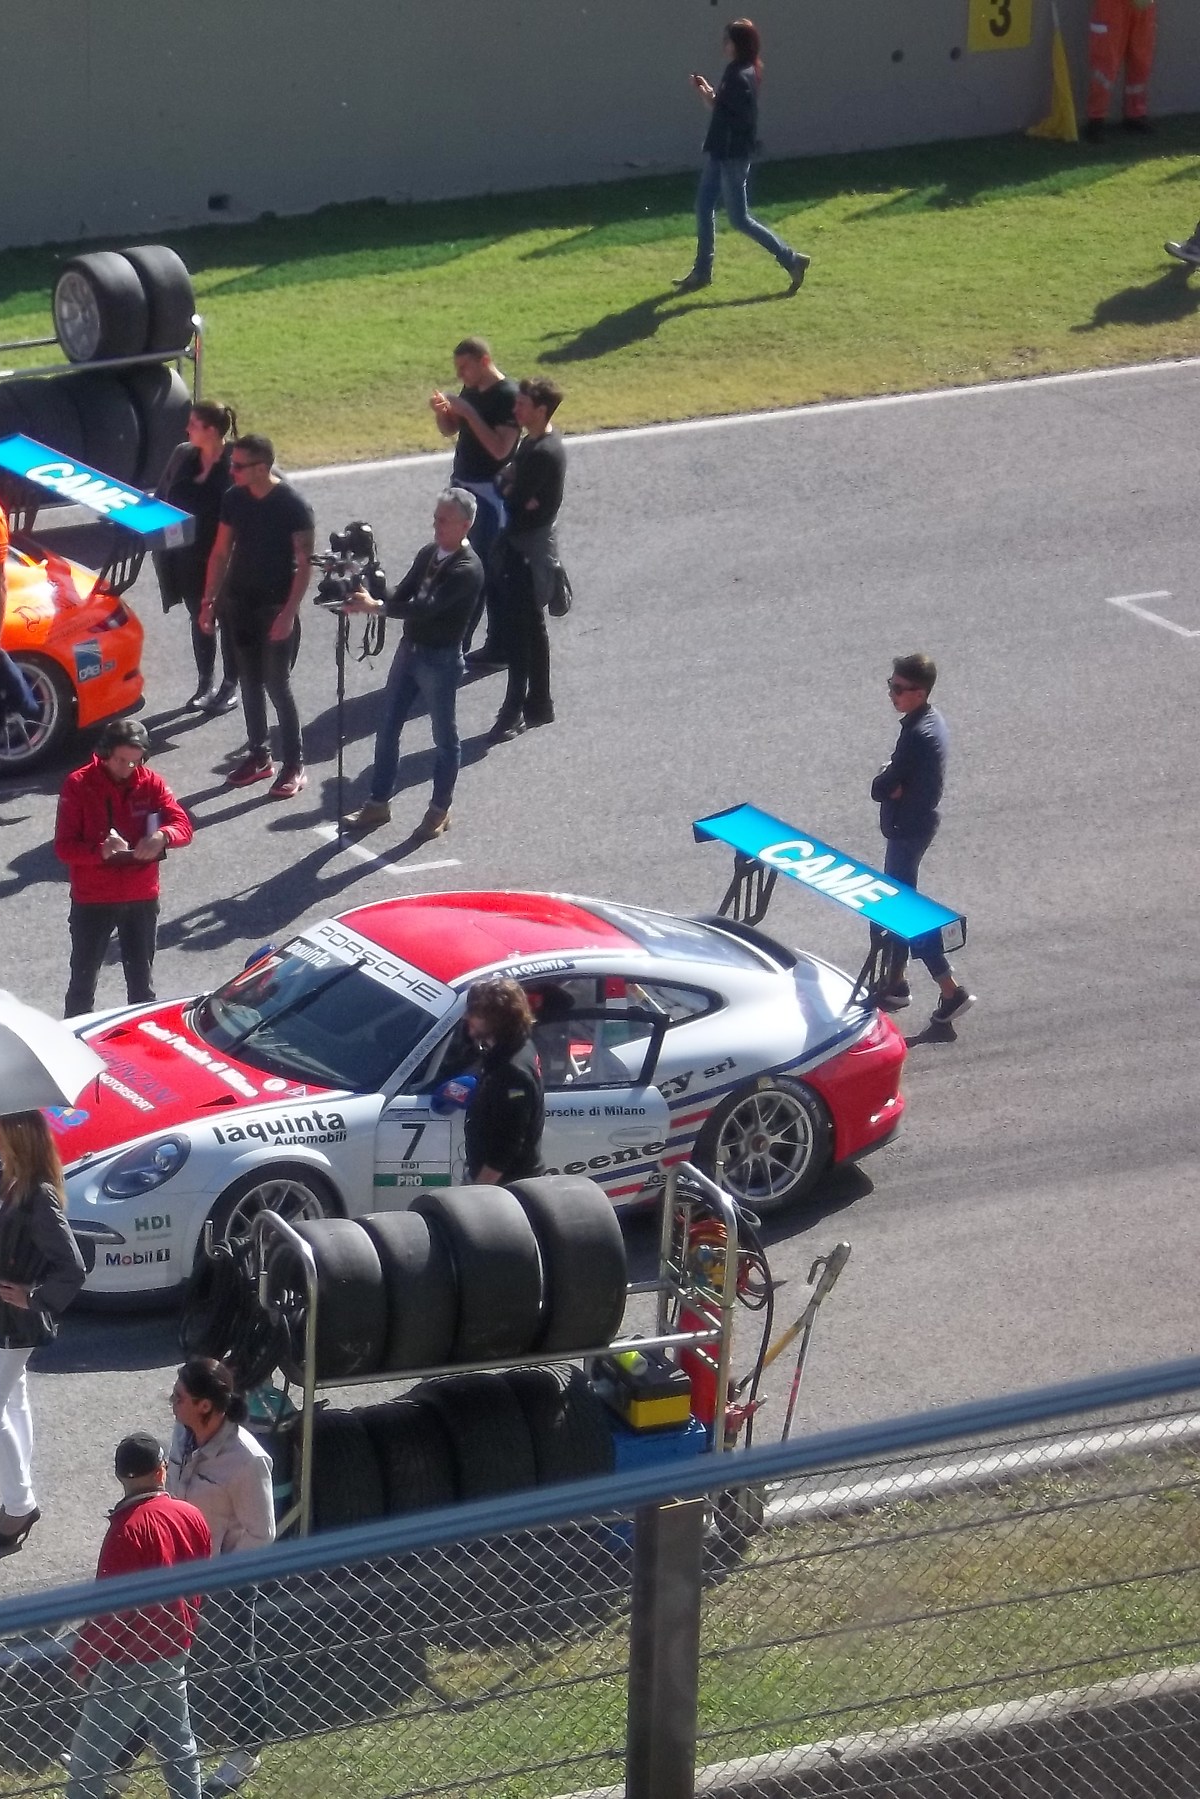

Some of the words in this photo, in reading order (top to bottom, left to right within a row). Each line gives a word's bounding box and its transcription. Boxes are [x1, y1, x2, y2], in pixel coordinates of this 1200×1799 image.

[989, 0, 1011, 37] 3
[26, 462, 140, 514] CAME
[758, 840, 900, 909] CAME
[317, 926, 442, 1002] PORSCHE
[703, 1056, 737, 1079] srl
[99, 1072, 155, 1111] MOTORSPORT
[544, 1107, 584, 1118] orsche
[589, 1101, 600, 1116] di
[604, 1101, 646, 1116] Milano
[274, 1131, 347, 1147] Automobili
[401, 1123, 426, 1160] 7
[397, 1175, 422, 1186] PRO
[134, 1214, 171, 1231] HDI
[105, 1250, 153, 1266] Mobil
